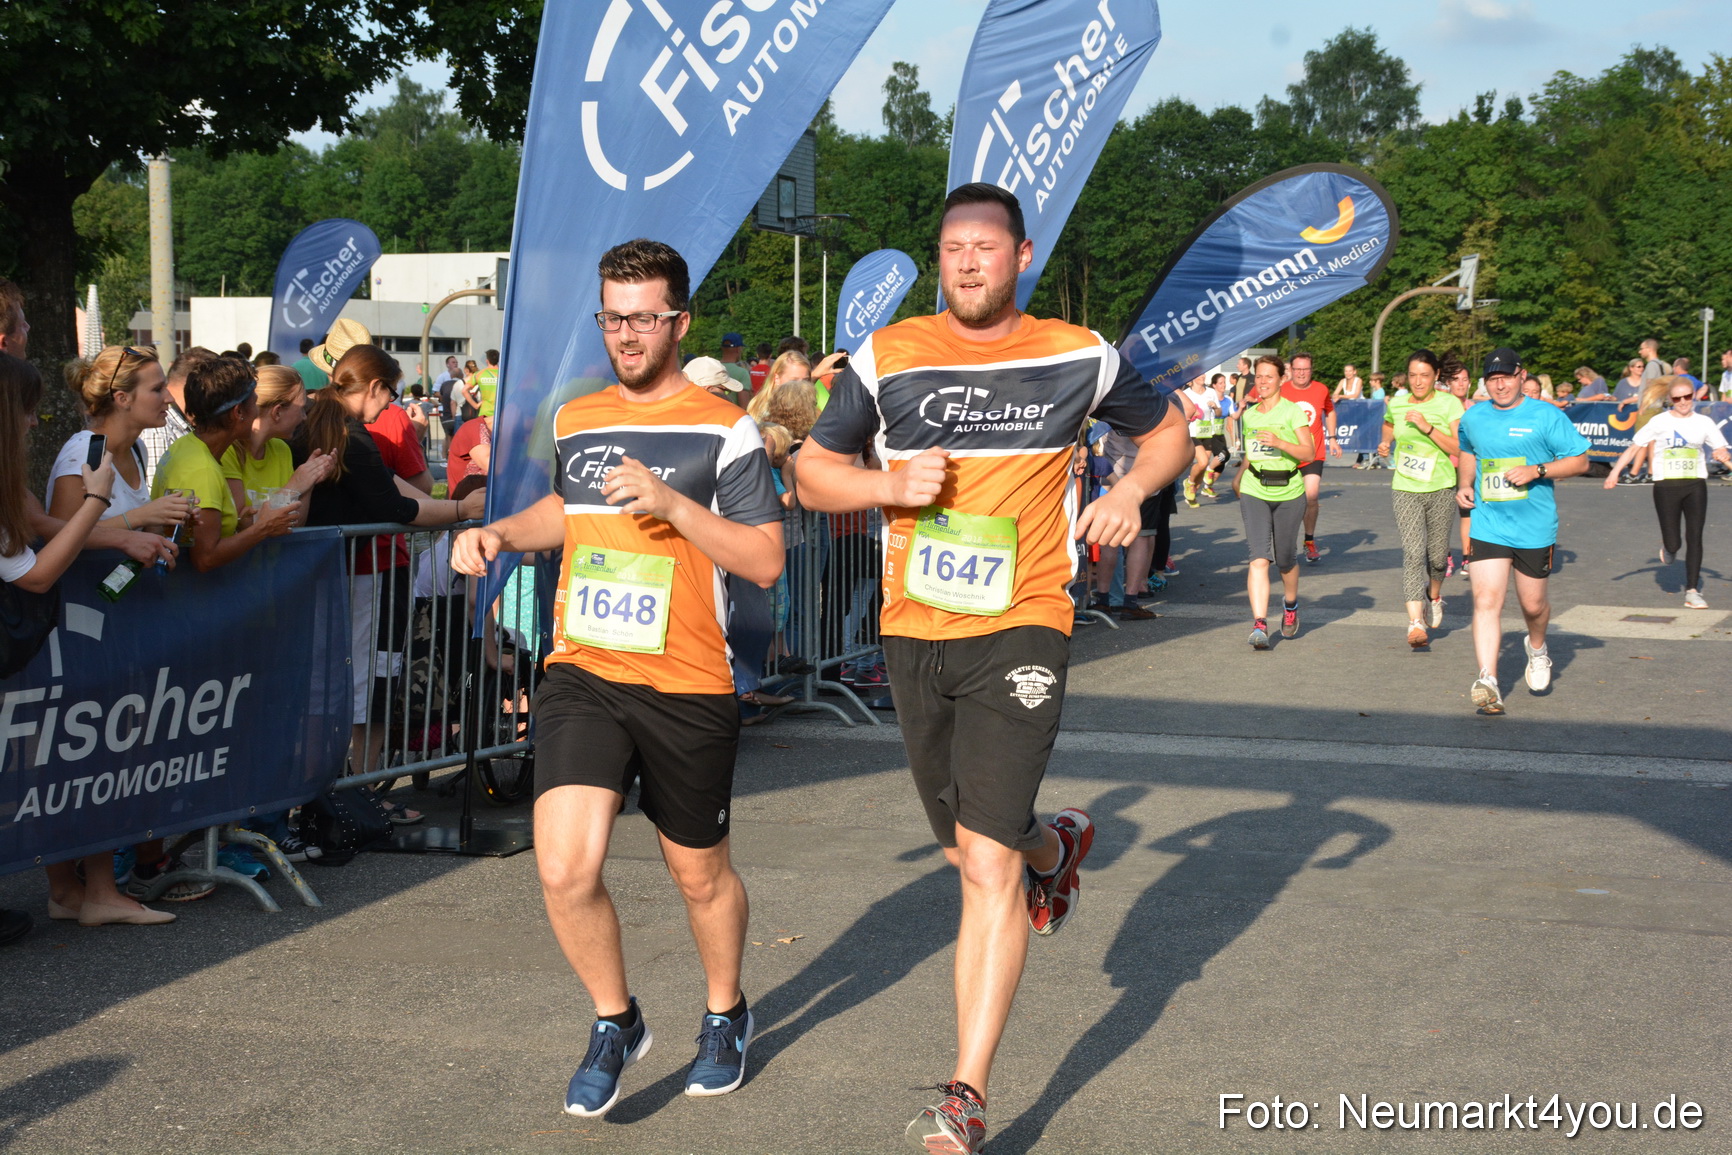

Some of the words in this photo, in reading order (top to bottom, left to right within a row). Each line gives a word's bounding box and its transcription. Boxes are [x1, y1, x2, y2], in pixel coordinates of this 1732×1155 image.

[639, 0, 777, 137] Fis
[297, 236, 357, 315] Fischer
[318, 252, 364, 314] AUTOMOBILE
[855, 263, 899, 327] Fischer
[1254, 282, 1298, 309] Druck
[1299, 266, 1328, 285] und
[1328, 236, 1380, 270] Medien
[870, 275, 905, 326] AUTOMOBILE
[1140, 248, 1319, 354] Frischmann
[943, 402, 1054, 421] Fischer
[953, 421, 1044, 432] AUTOMOBILE
[1403, 455, 1427, 472] 224
[1668, 460, 1695, 471] 1583
[919, 545, 1004, 587] 1647
[577, 585, 657, 626] 1648
[924, 583, 952, 597] Christian
[952, 590, 986, 601] Woschnik
[587, 624, 609, 634] Bastian
[0, 666, 252, 773] Fischer
[13, 746, 230, 822] AUTOMOBILE
